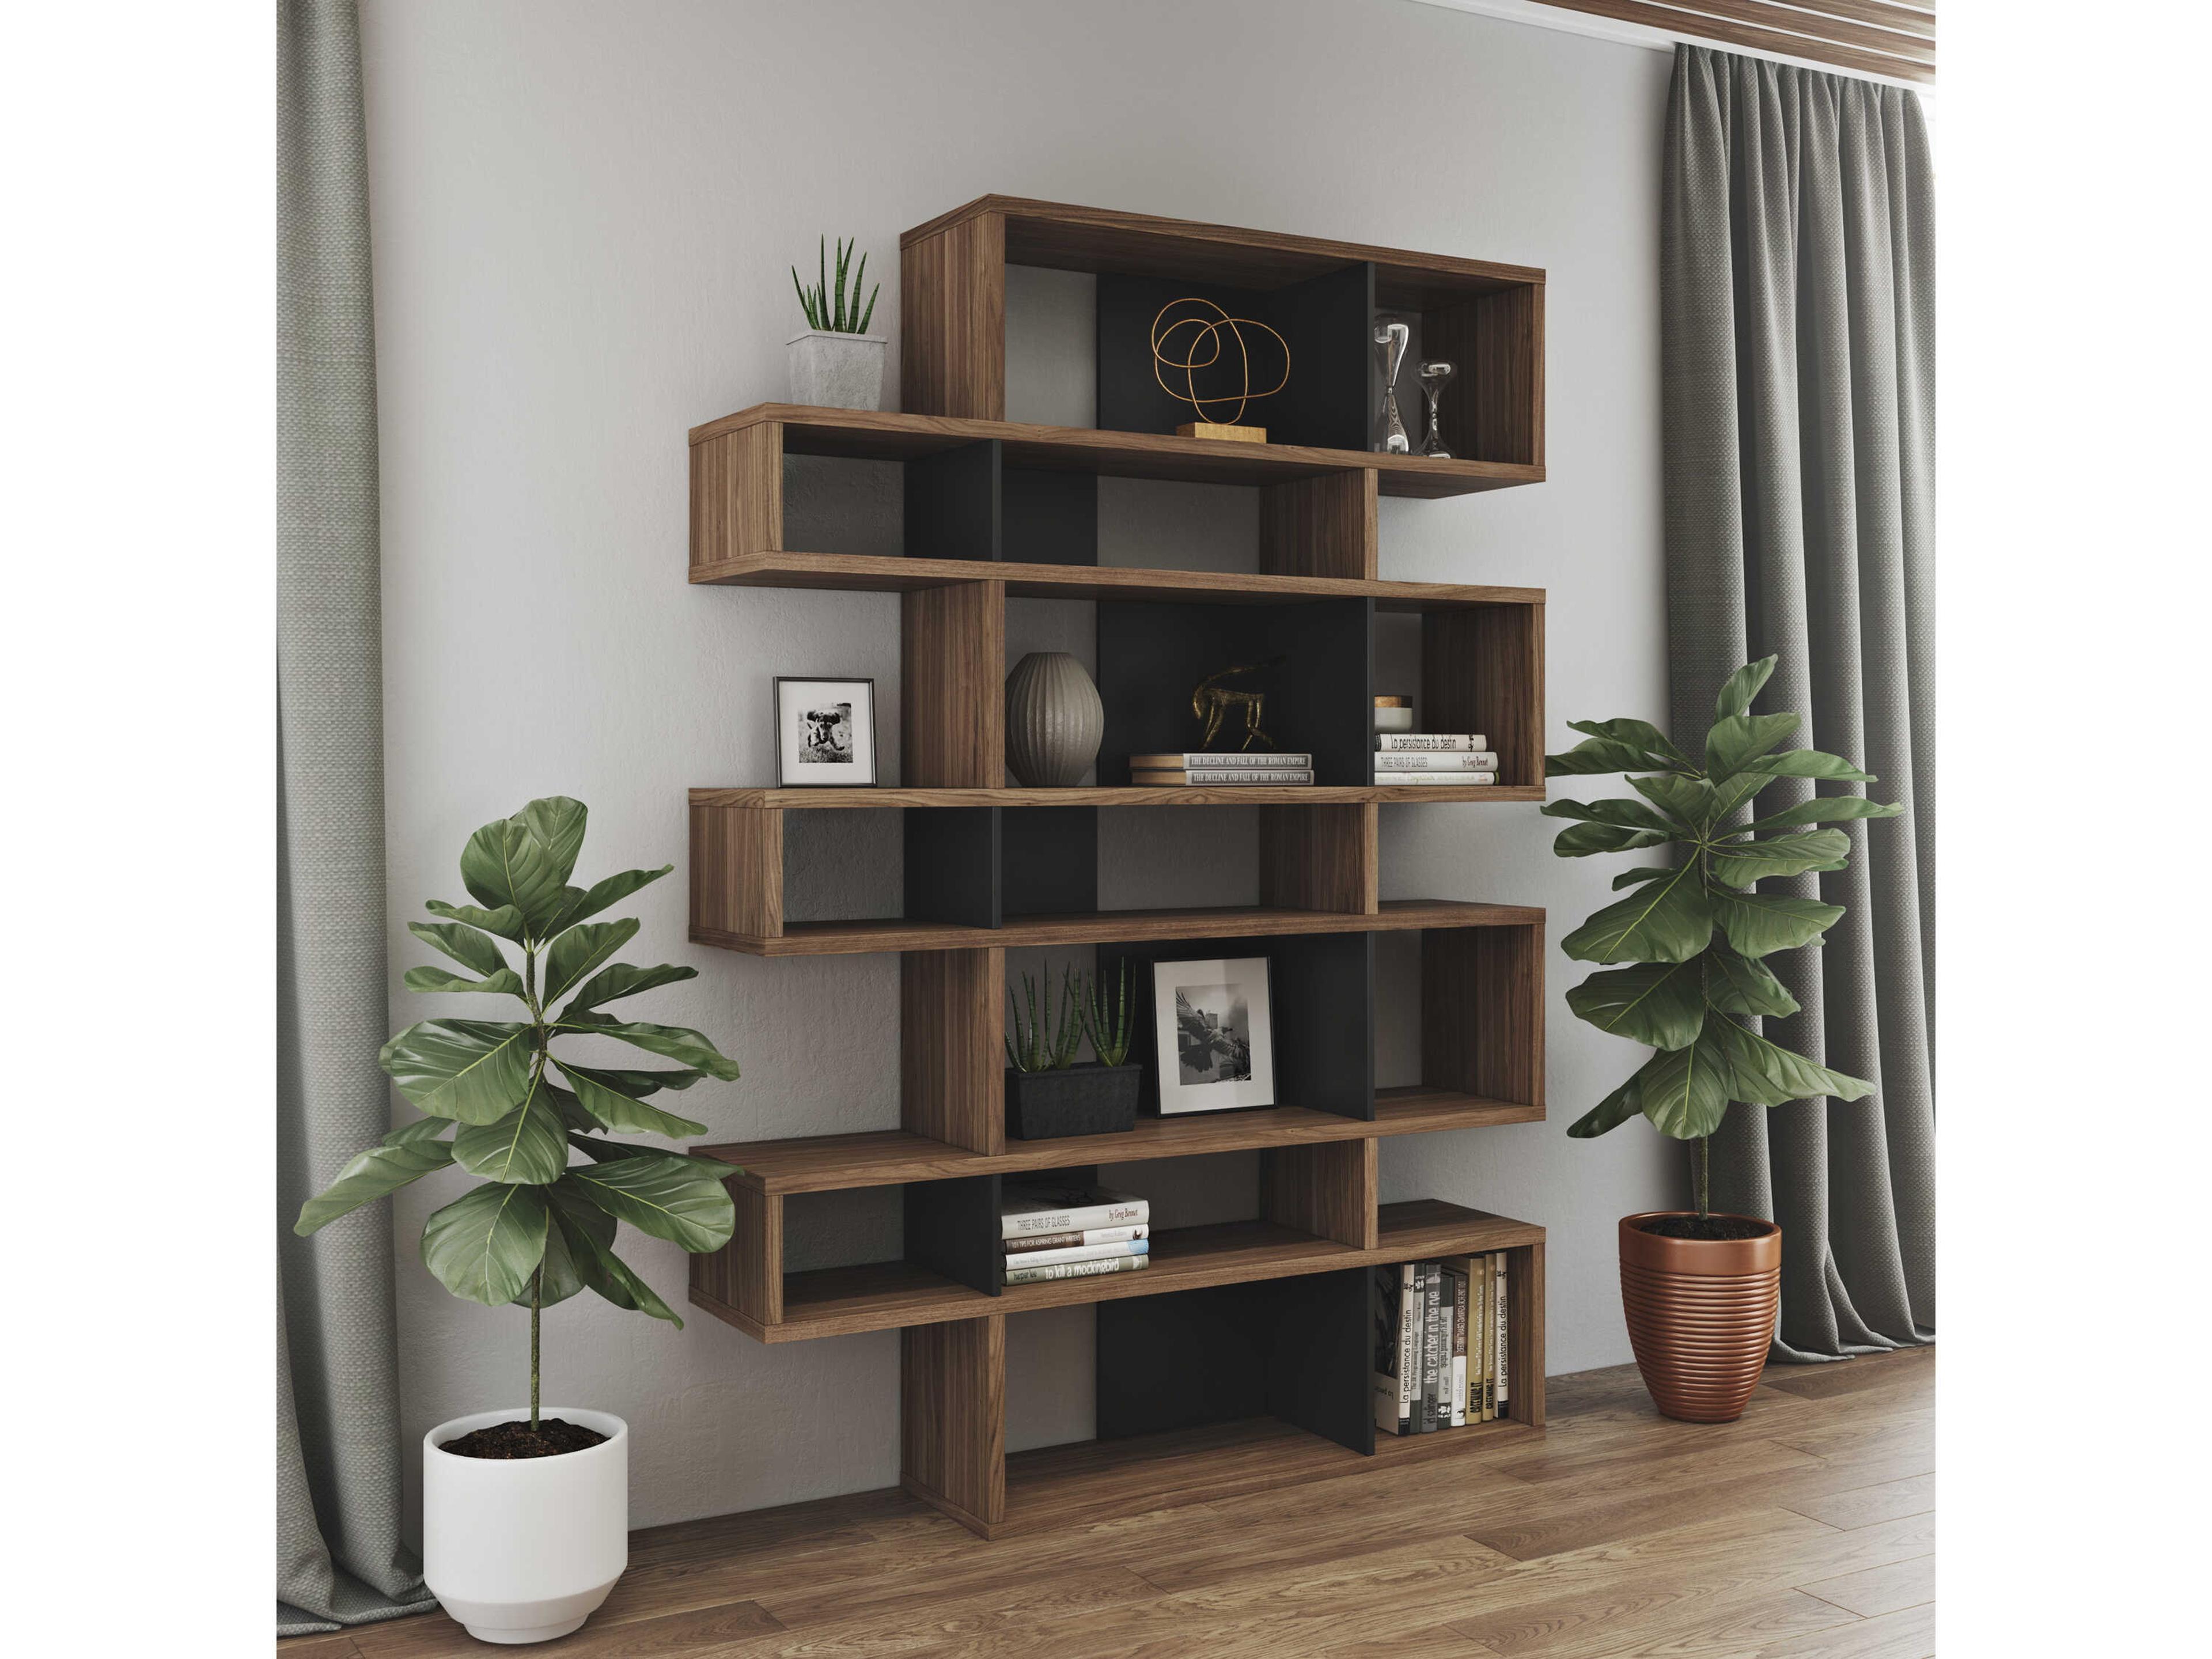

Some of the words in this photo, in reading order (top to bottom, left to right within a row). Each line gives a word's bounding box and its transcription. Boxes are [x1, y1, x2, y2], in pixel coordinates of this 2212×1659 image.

[1226, 757, 1236, 765] AND
[1045, 1267, 1054, 1279] to
[1067, 1266, 1072, 1277] a
[1074, 1257, 1120, 1277] mockingbird
[1429, 1291, 1441, 1305] rye
[1425, 1307, 1440, 1323] the
[1498, 1296, 1506, 1319] destin
[1402, 1309, 1412, 1333] destin
[1425, 1324, 1440, 1334] in
[1498, 1321, 1507, 1331] du
[1401, 1335, 1411, 1346] du
[1424, 1334, 1439, 1367] catcher
[1499, 1332, 1508, 1376] persistance
[1401, 1348, 1411, 1392] persistance
[1423, 1369, 1438, 1384] the
